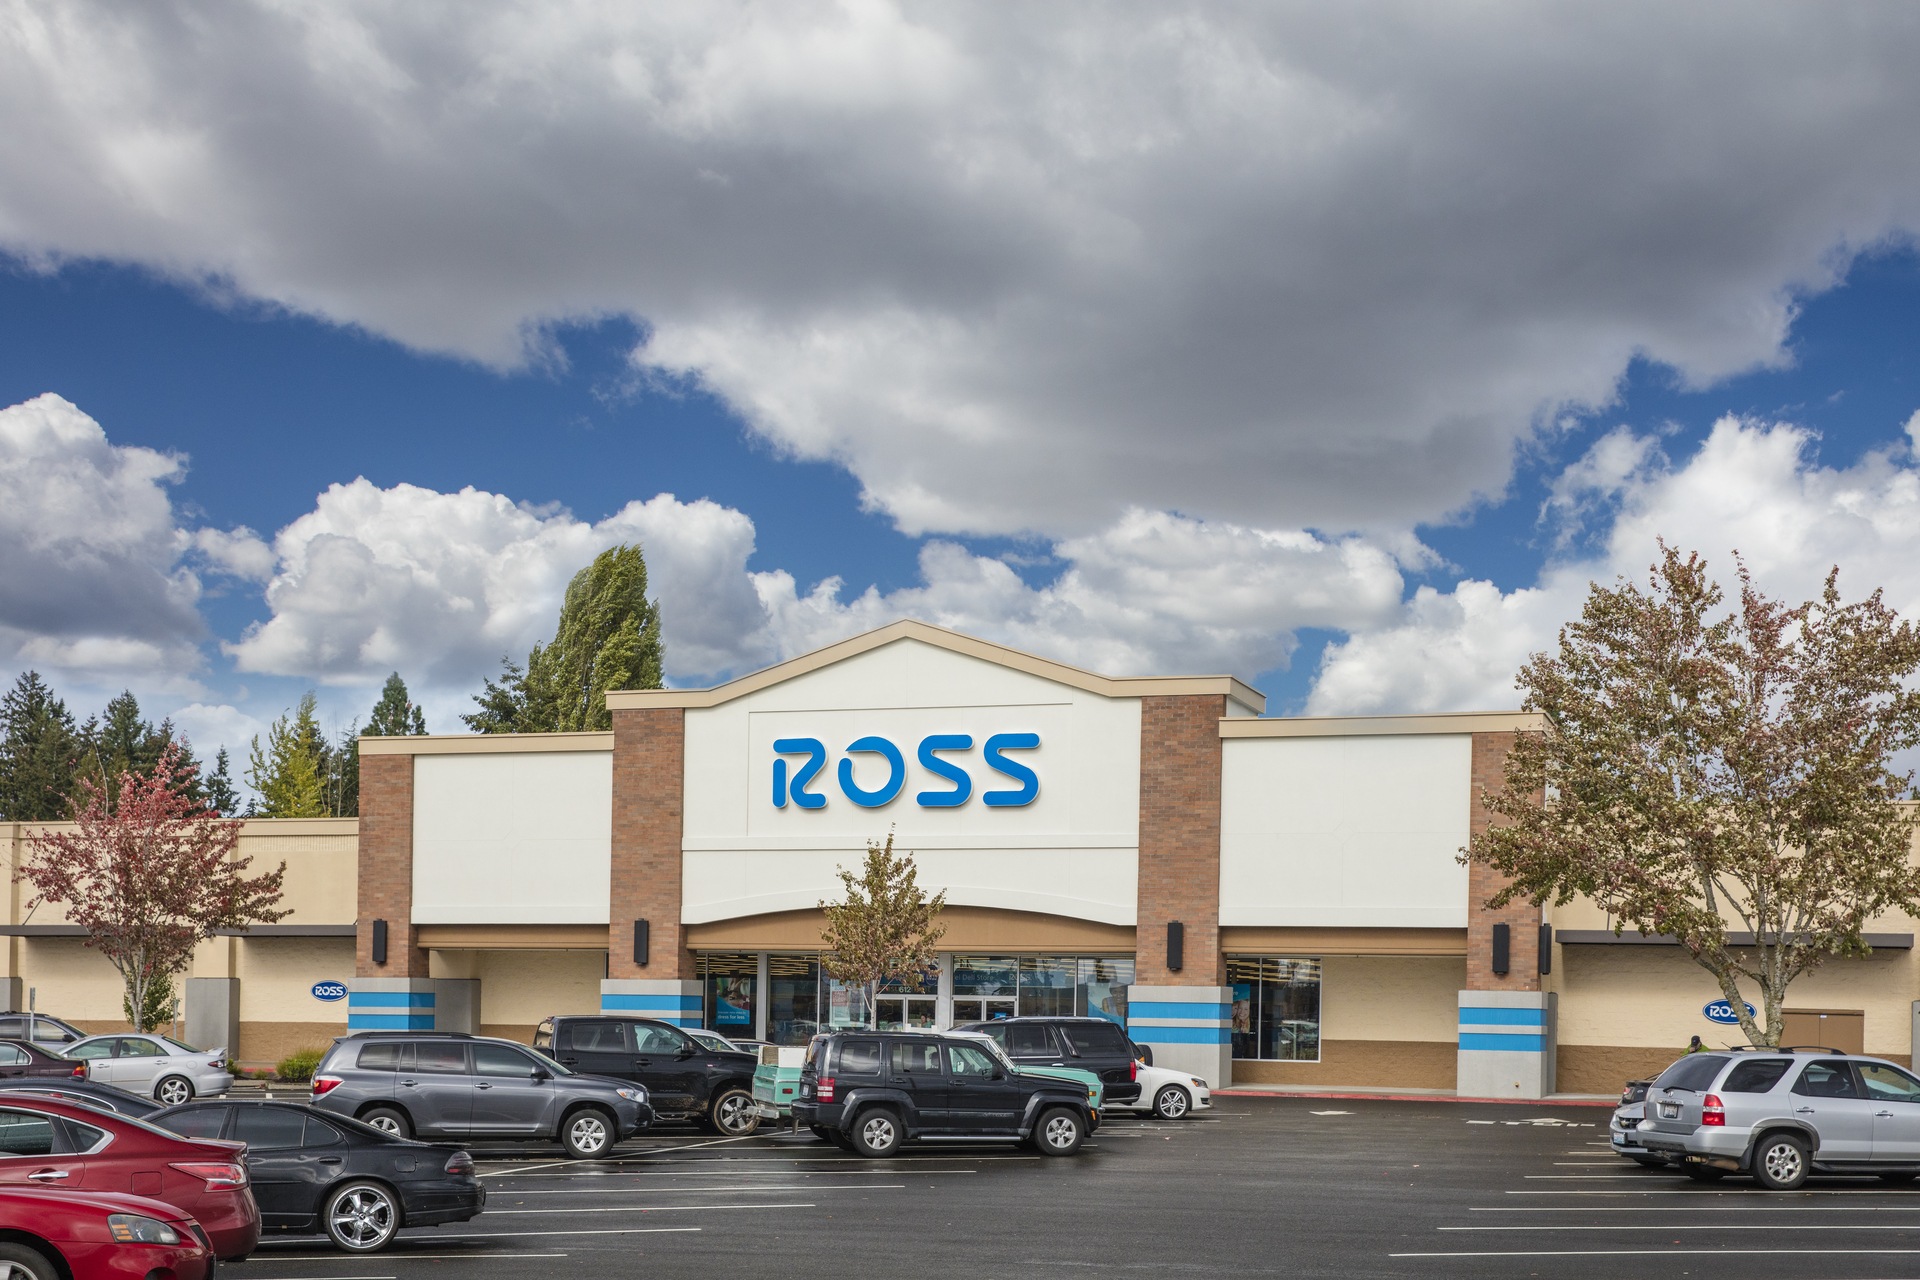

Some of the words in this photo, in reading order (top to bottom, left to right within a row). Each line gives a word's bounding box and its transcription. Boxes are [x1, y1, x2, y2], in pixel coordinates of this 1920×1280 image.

[772, 732, 1041, 809] ROSS
[315, 986, 344, 996] ROSS
[1710, 1005, 1751, 1018] RO
